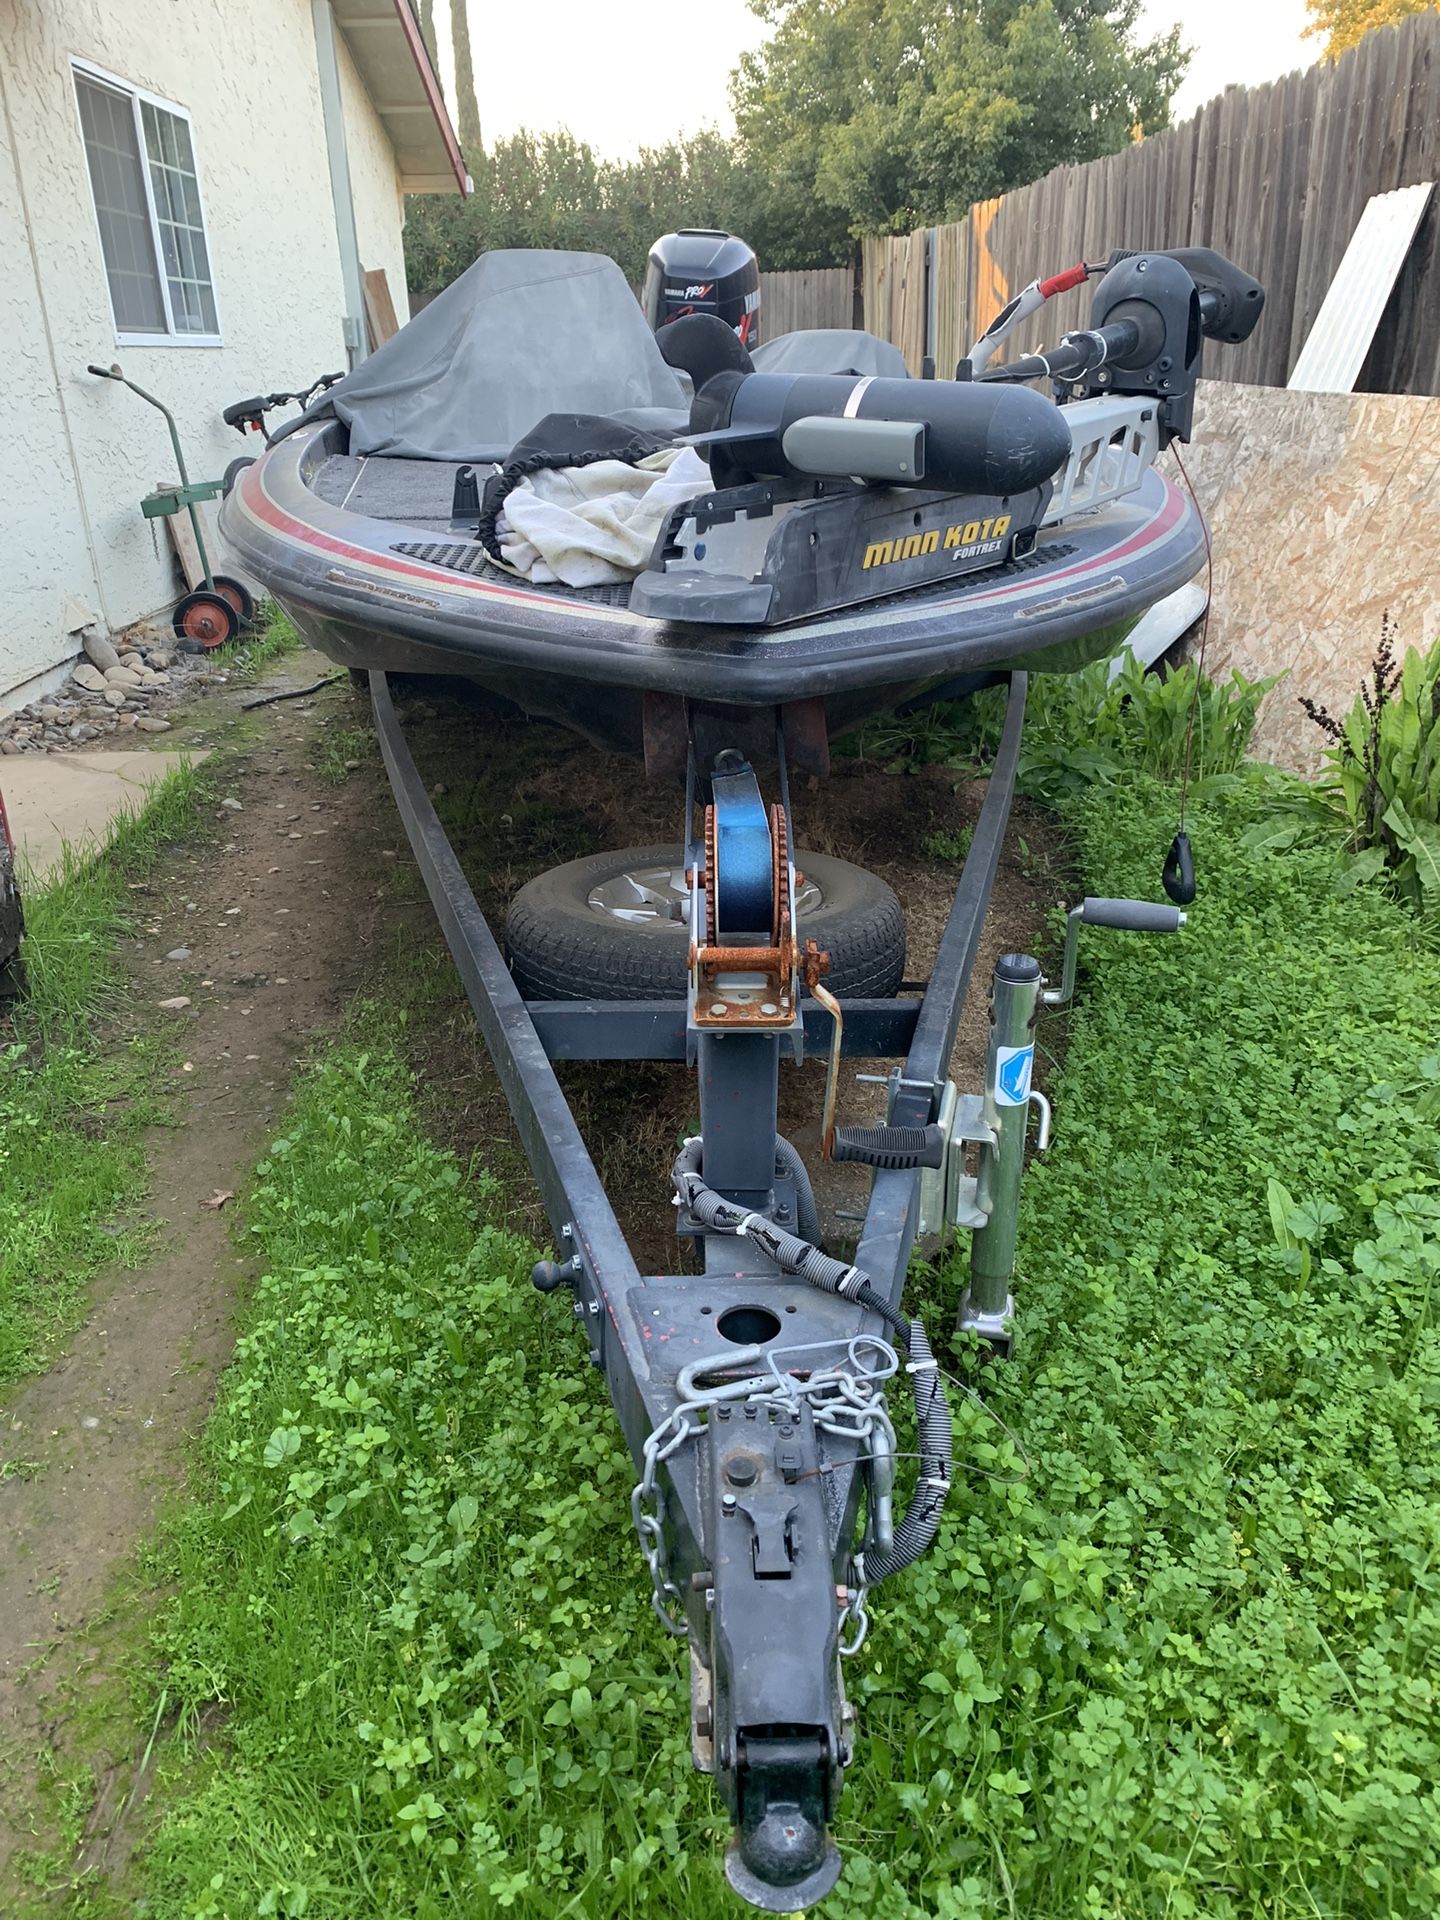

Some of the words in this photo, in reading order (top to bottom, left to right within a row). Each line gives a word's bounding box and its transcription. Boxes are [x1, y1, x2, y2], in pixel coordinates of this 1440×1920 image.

[664, 288, 685, 297] YAMAHA
[862, 530, 940, 570] MINN
[943, 514, 1012, 550] KOTA
[952, 540, 1002, 561] FORTREX
